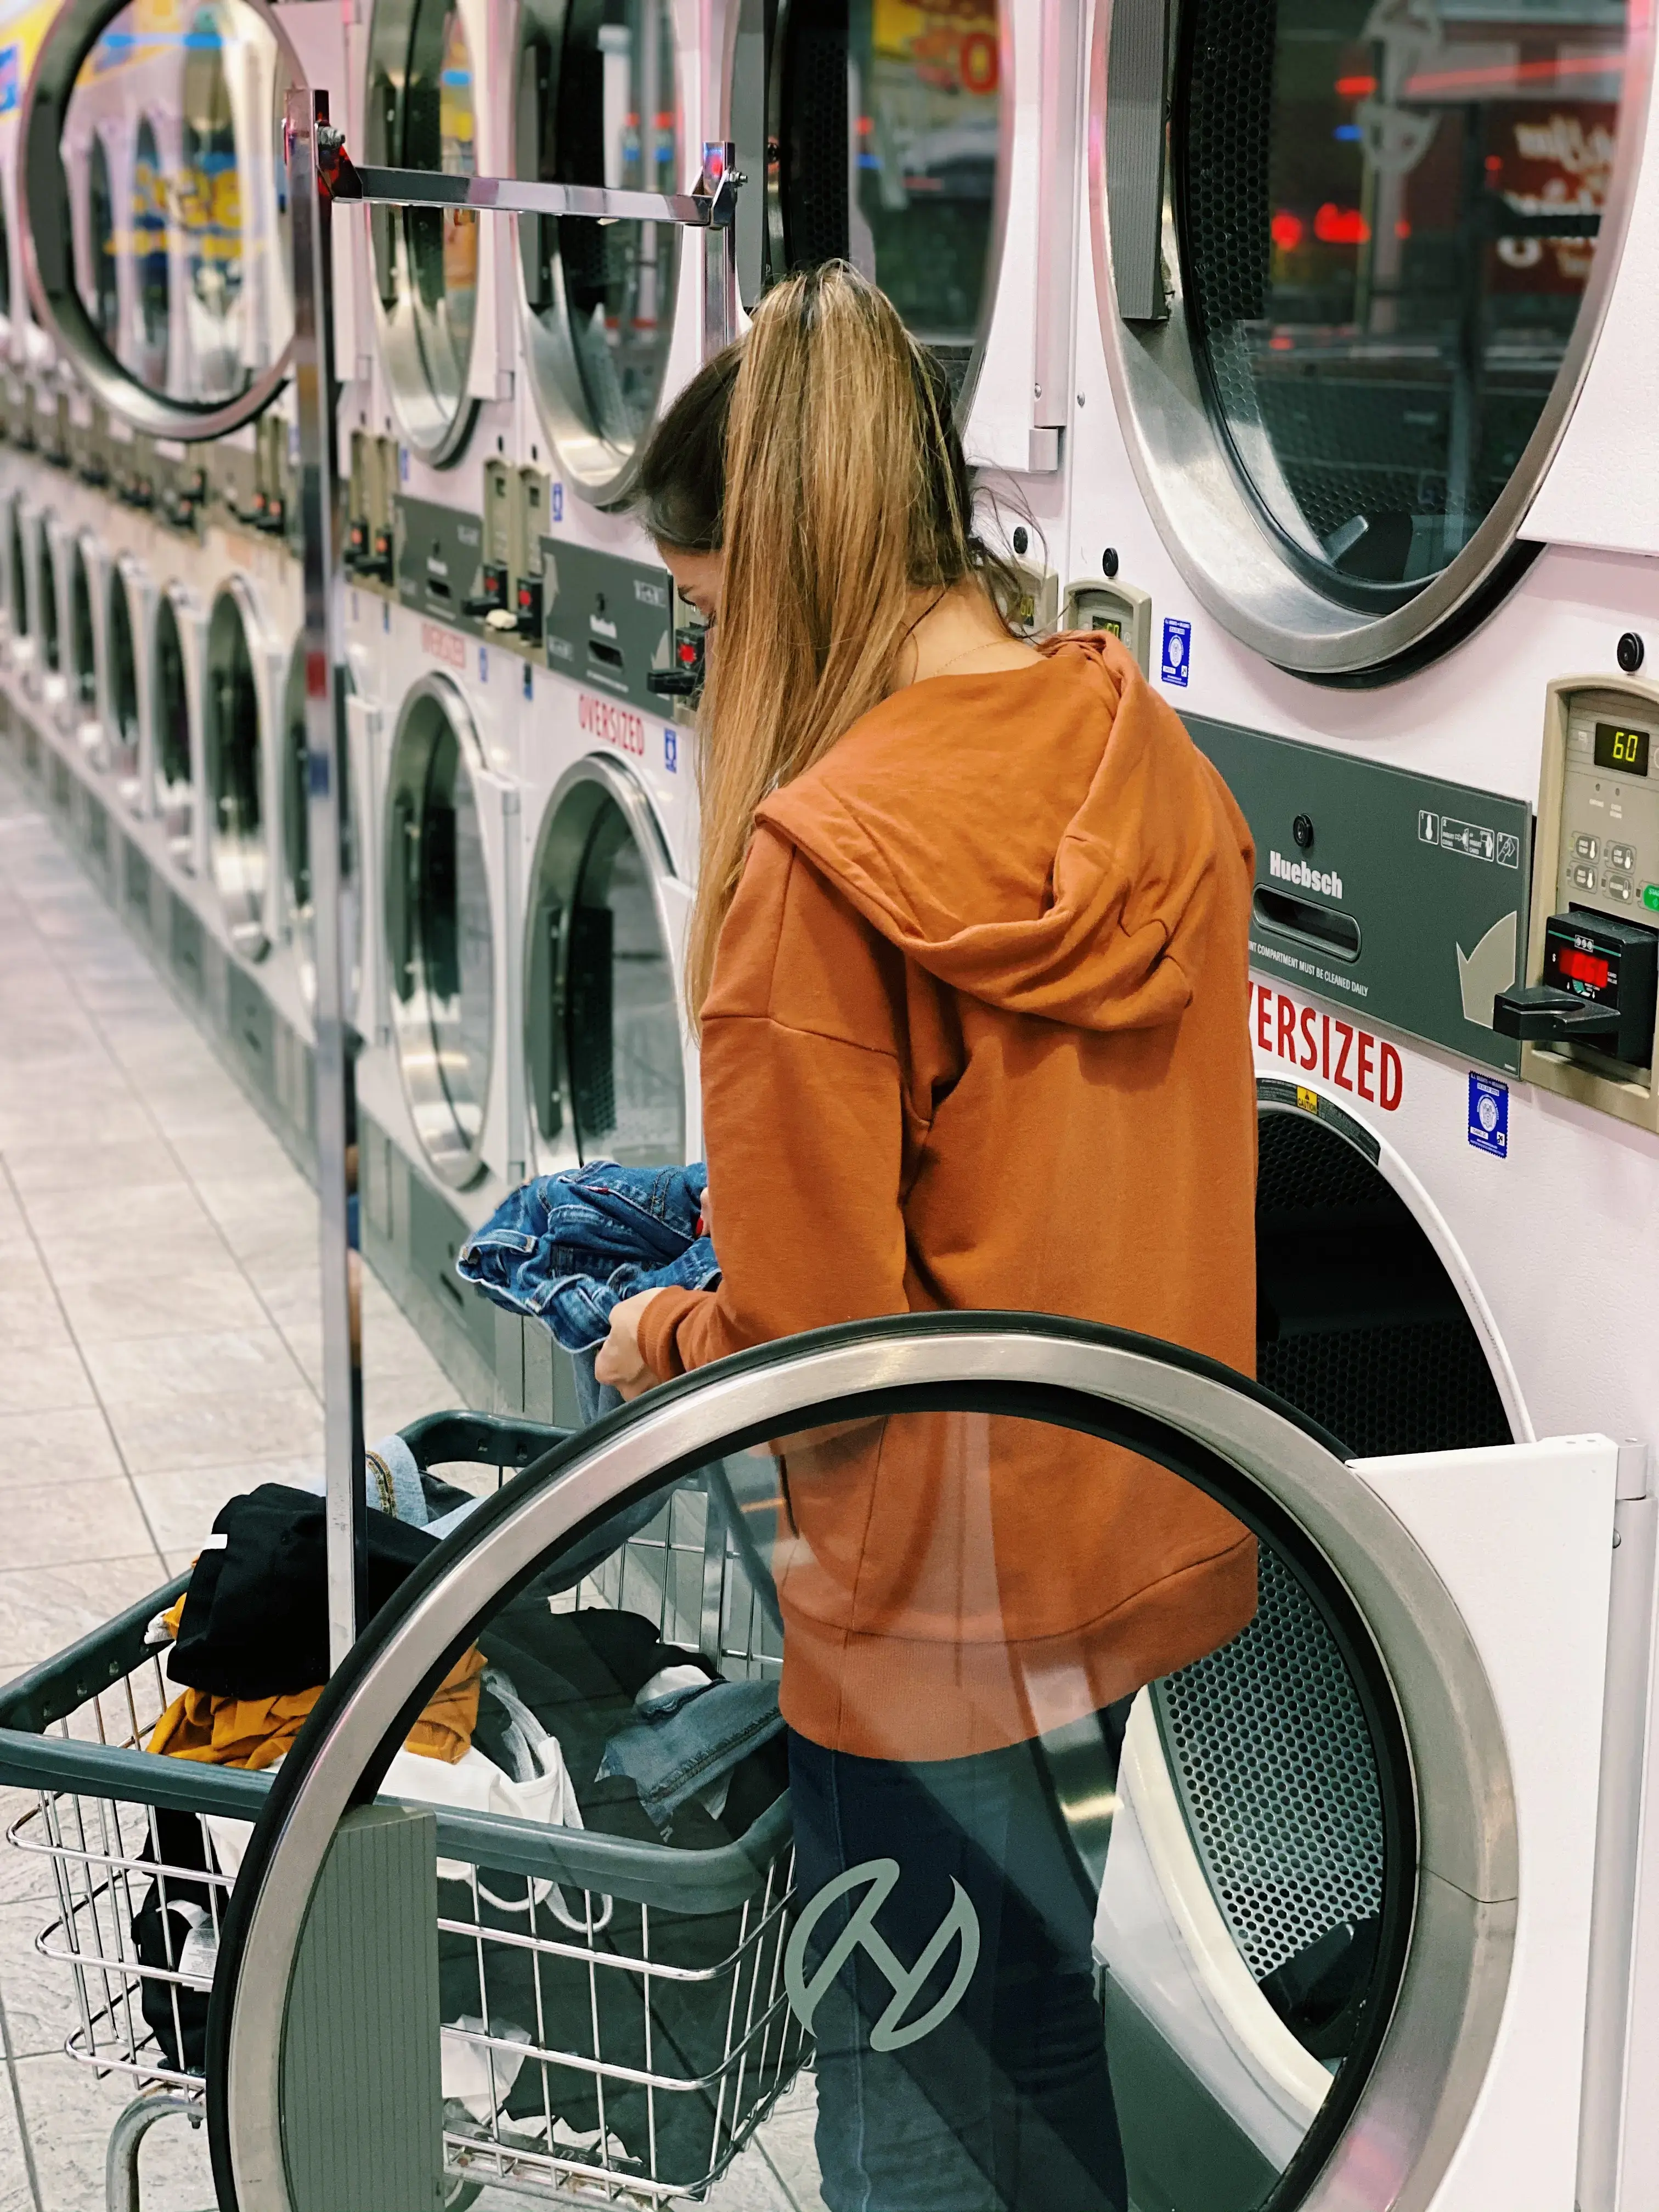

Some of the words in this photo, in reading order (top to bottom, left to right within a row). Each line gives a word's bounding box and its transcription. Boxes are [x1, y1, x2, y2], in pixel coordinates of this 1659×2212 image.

[1613, 731, 1638, 762] 60
[1270, 850, 1343, 899] Huebsch
[1249, 940, 1258, 952] INT
[1257, 944, 1299, 970] COMPARTMENT
[1299, 962, 1316, 975] MUST
[1316, 967, 1324, 979] BE
[1324, 970, 1351, 990] CLEANED
[1351, 981, 1368, 997] DAILY
[1249, 981, 1403, 1111] ERSIZED
[1298, 1098, 1317, 1112] CAUTION
